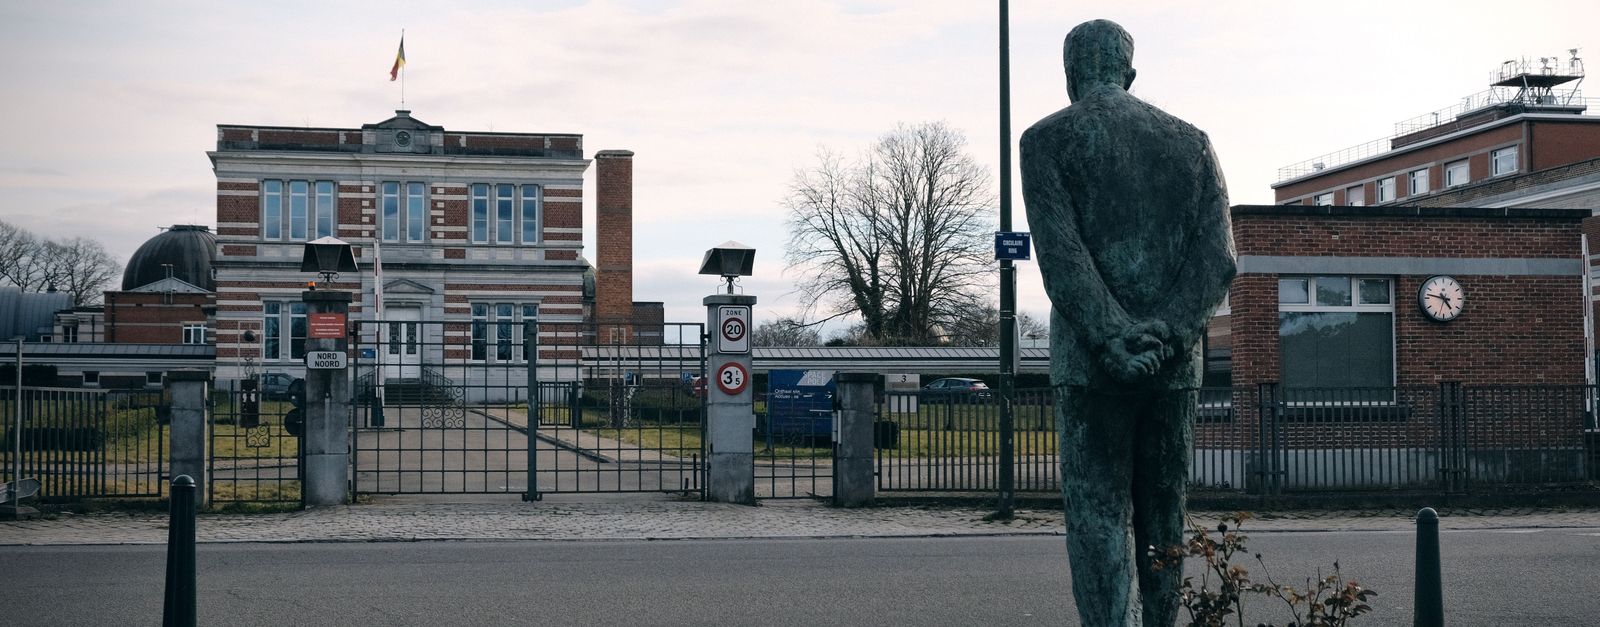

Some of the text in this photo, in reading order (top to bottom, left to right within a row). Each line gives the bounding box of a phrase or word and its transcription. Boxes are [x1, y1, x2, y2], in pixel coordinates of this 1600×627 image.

[726, 324, 741, 335] 20
[317, 352, 338, 360] NORD
[723, 370, 733, 385] 3
[901, 375, 907, 383] 3
